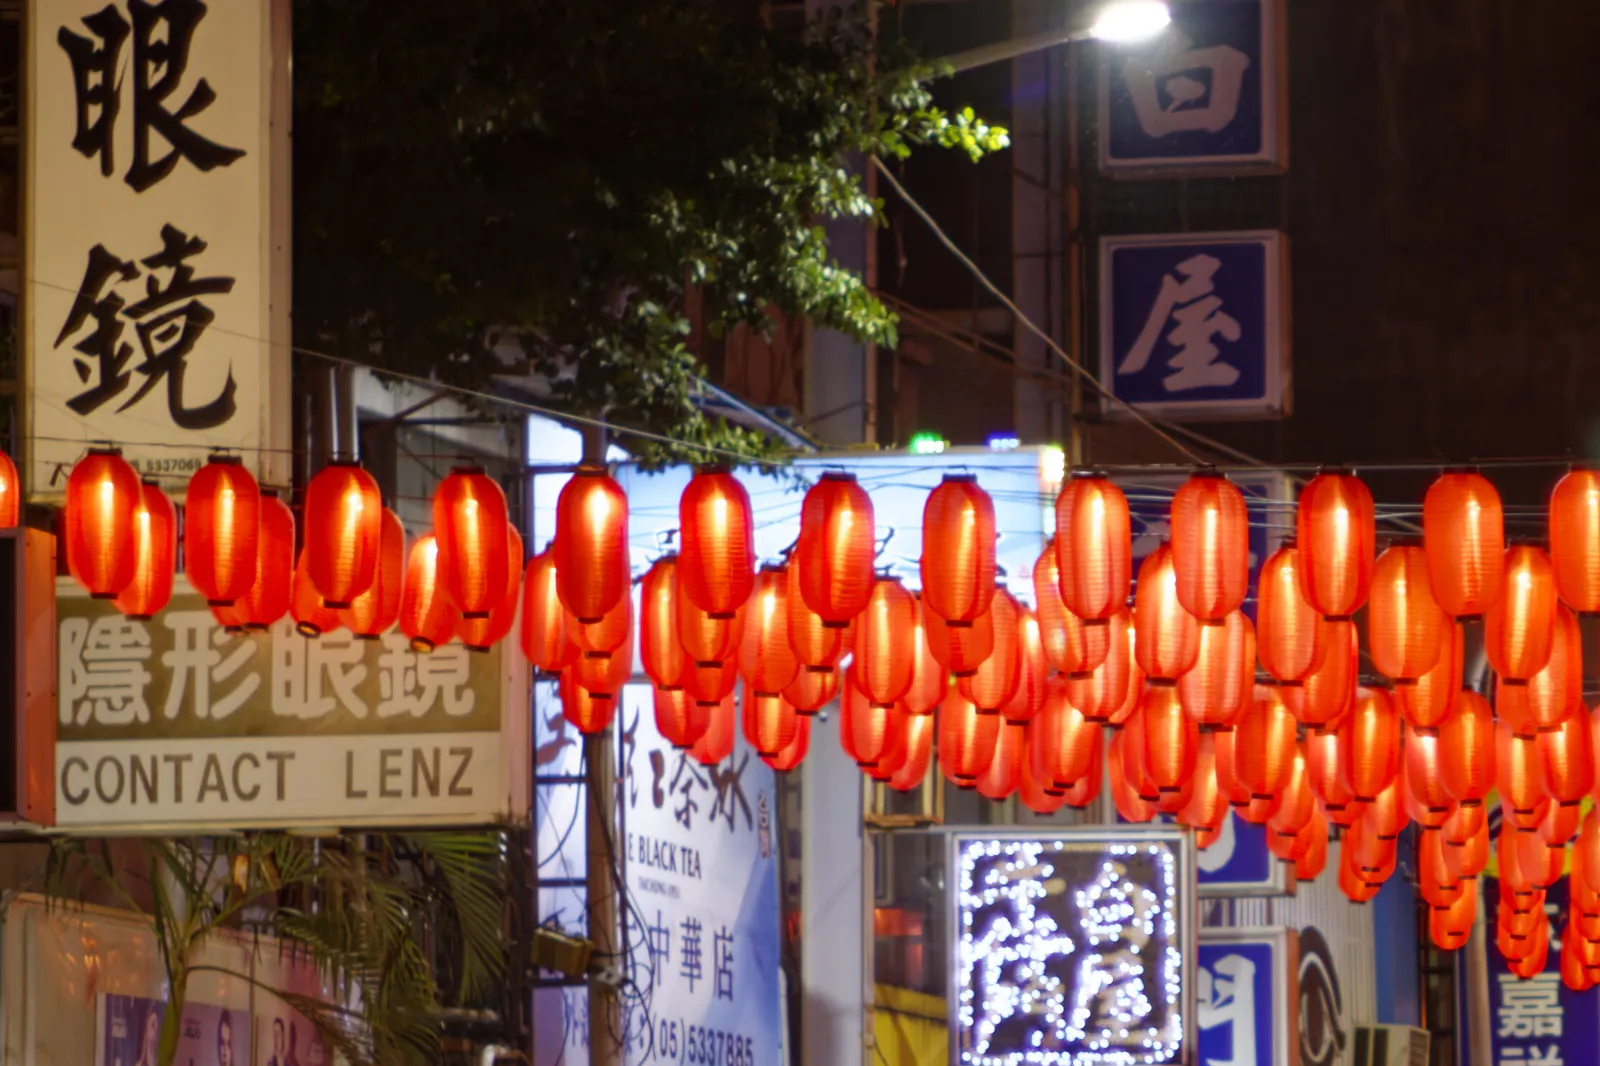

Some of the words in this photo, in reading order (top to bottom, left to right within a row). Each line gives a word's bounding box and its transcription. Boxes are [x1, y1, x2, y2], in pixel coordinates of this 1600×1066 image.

[53, 0, 247, 429] 眼鏡
[58, 612, 476, 726] 隱形眼鏡
[60, 752, 296, 806] CONTACT
[346, 747, 475, 798] LENZ
[638, 837, 677, 873] BLACK
[681, 848, 702, 879] TEA
